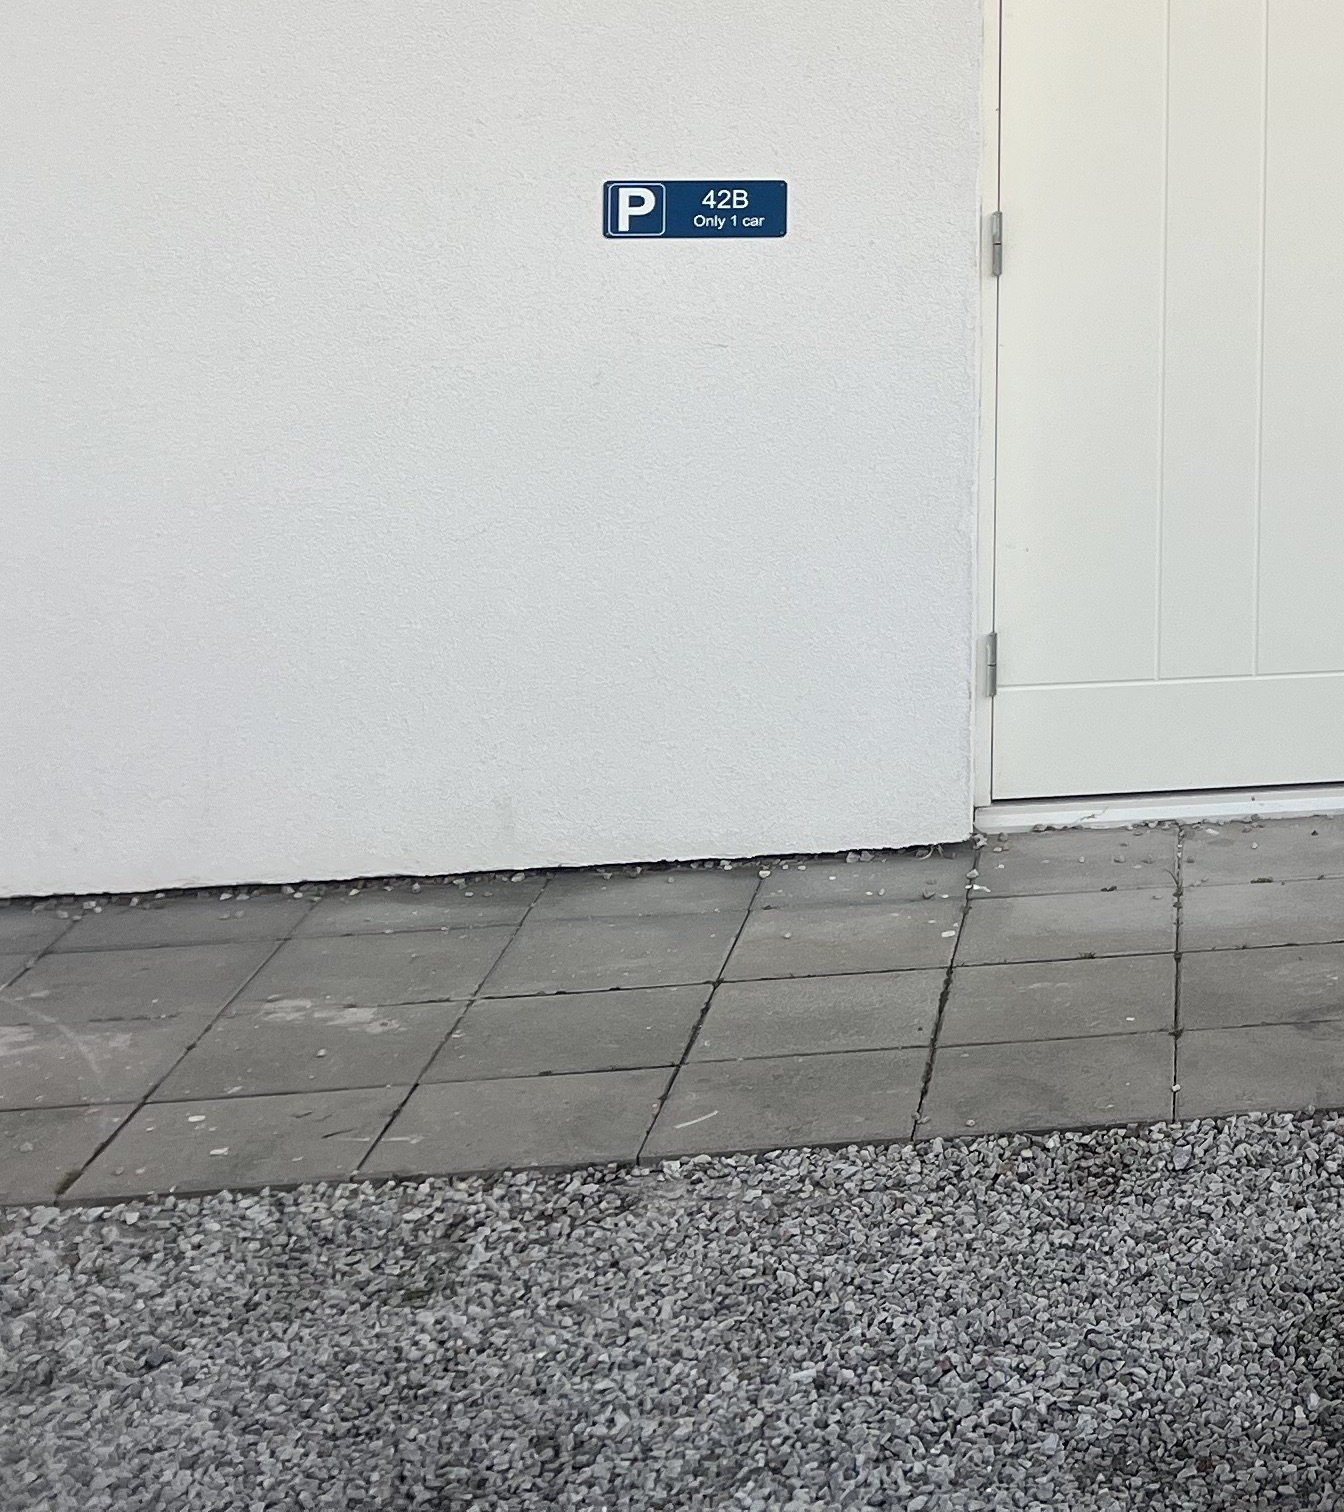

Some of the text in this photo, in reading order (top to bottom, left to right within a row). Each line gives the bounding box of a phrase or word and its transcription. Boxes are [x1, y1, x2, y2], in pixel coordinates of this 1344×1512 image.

[702, 189, 749, 209] 42B
[618, 187, 656, 232] P
[693, 214, 765, 230] Only 1 car
